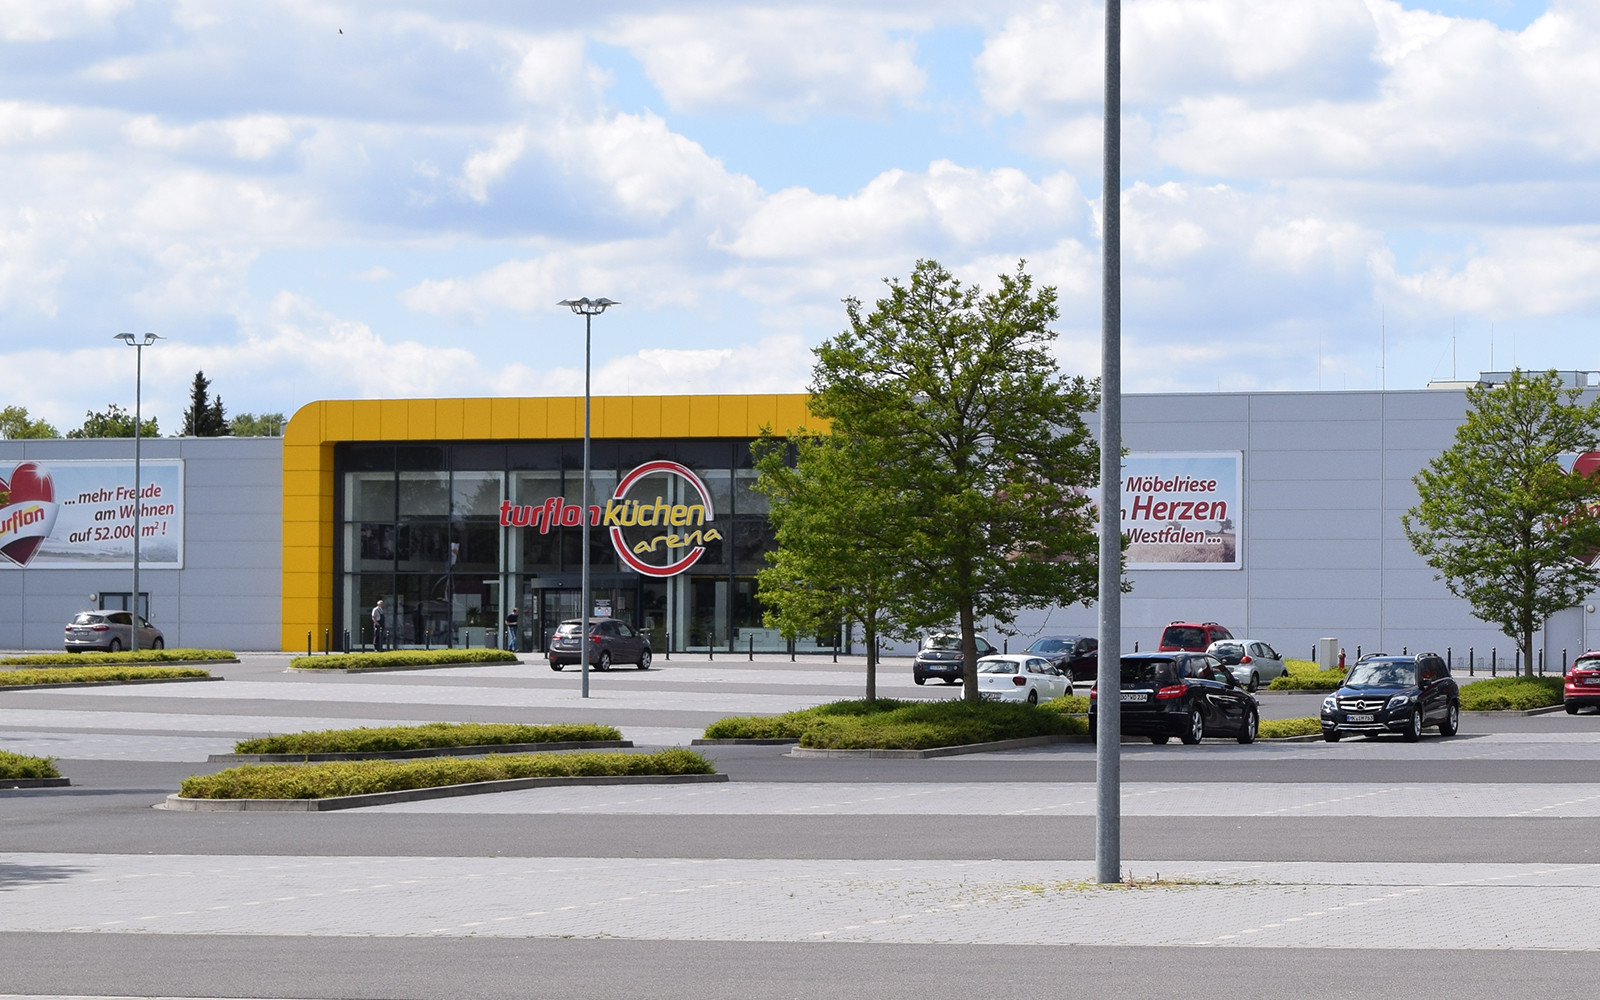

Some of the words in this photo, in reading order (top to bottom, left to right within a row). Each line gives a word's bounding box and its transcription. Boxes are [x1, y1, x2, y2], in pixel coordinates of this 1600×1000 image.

[1126, 476, 1217, 492] Möbelriese
[78, 488, 114, 504] mehr
[116, 484, 162, 500] Freude
[94, 509, 116, 522] am
[500, 497, 600, 534] turflon
[603, 496, 705, 526] küchen
[1131, 496, 1227, 520] Herzen
[69, 528, 93, 543] auf
[633, 528, 722, 554] arena
[1127, 528, 1204, 543] Westfalen
